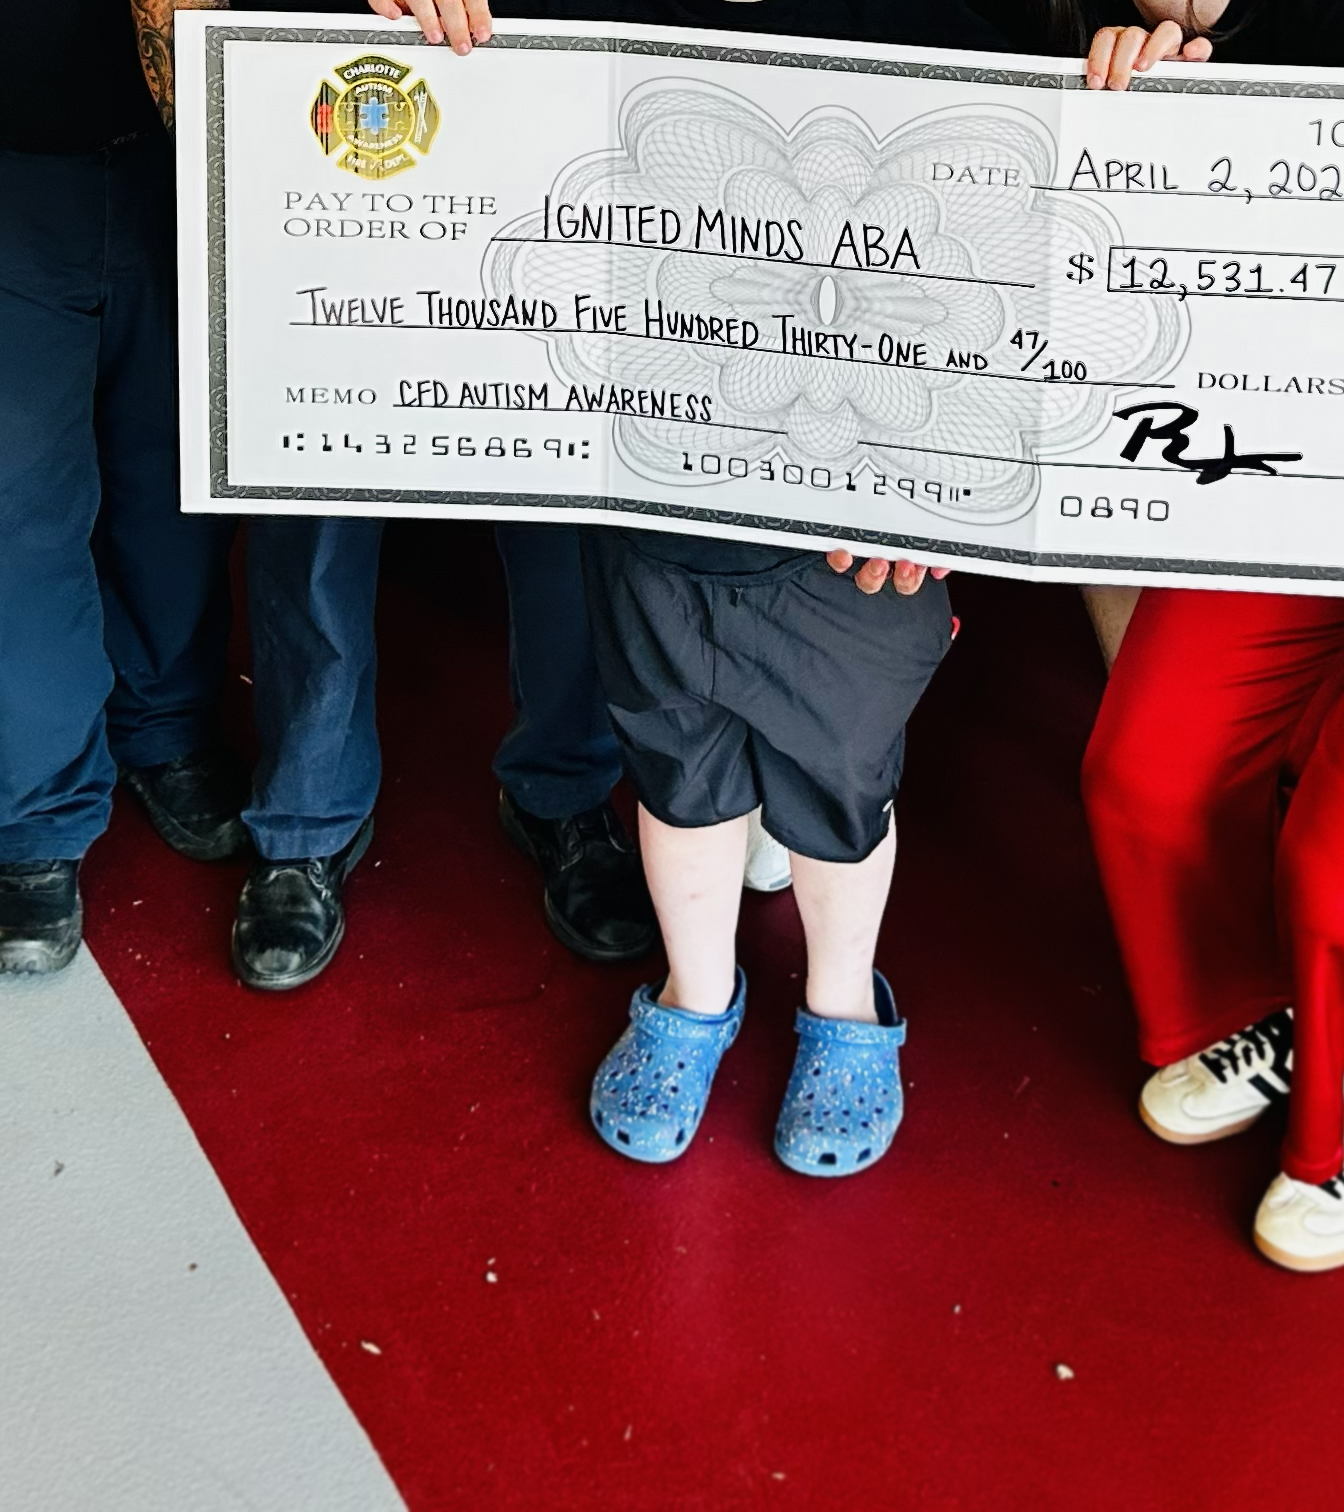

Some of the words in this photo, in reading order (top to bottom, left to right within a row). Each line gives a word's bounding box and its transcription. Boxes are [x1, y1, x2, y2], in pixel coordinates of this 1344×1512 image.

[343, 63, 401, 80] CHARLOTTE
[356, 82, 393, 95] AUTISM
[931, 162, 1021, 188] DATE
[1068, 147, 1179, 191] APRIL
[1207, 156, 1252, 204] 2,
[284, 191, 354, 214] PAY
[364, 192, 413, 213] TO
[422, 194, 497, 216] THE
[284, 219, 410, 241] ORDER
[419, 221, 468, 242] OF
[544, 194, 681, 244] IGNITED
[694, 203, 805, 262] MINDS
[831, 221, 921, 271] ABA
[1066, 252, 1095, 284] $
[1119, 255, 1337, 302] 12,531.47
[296, 287, 405, 327] TWELVE
[416, 289, 558, 330] THOUSAND
[574, 295, 628, 333] FIVE
[644, 298, 759, 349] HUNDRED
[772, 314, 928, 369] THIRTY-ONE
[946, 355, 989, 372] AND
[285, 387, 377, 405] MEMO
[398, 379, 449, 409] CFD
[459, 382, 549, 412] AUTISM
[566, 384, 712, 423] AWARENESS
[1060, 495, 1170, 522] 0890
